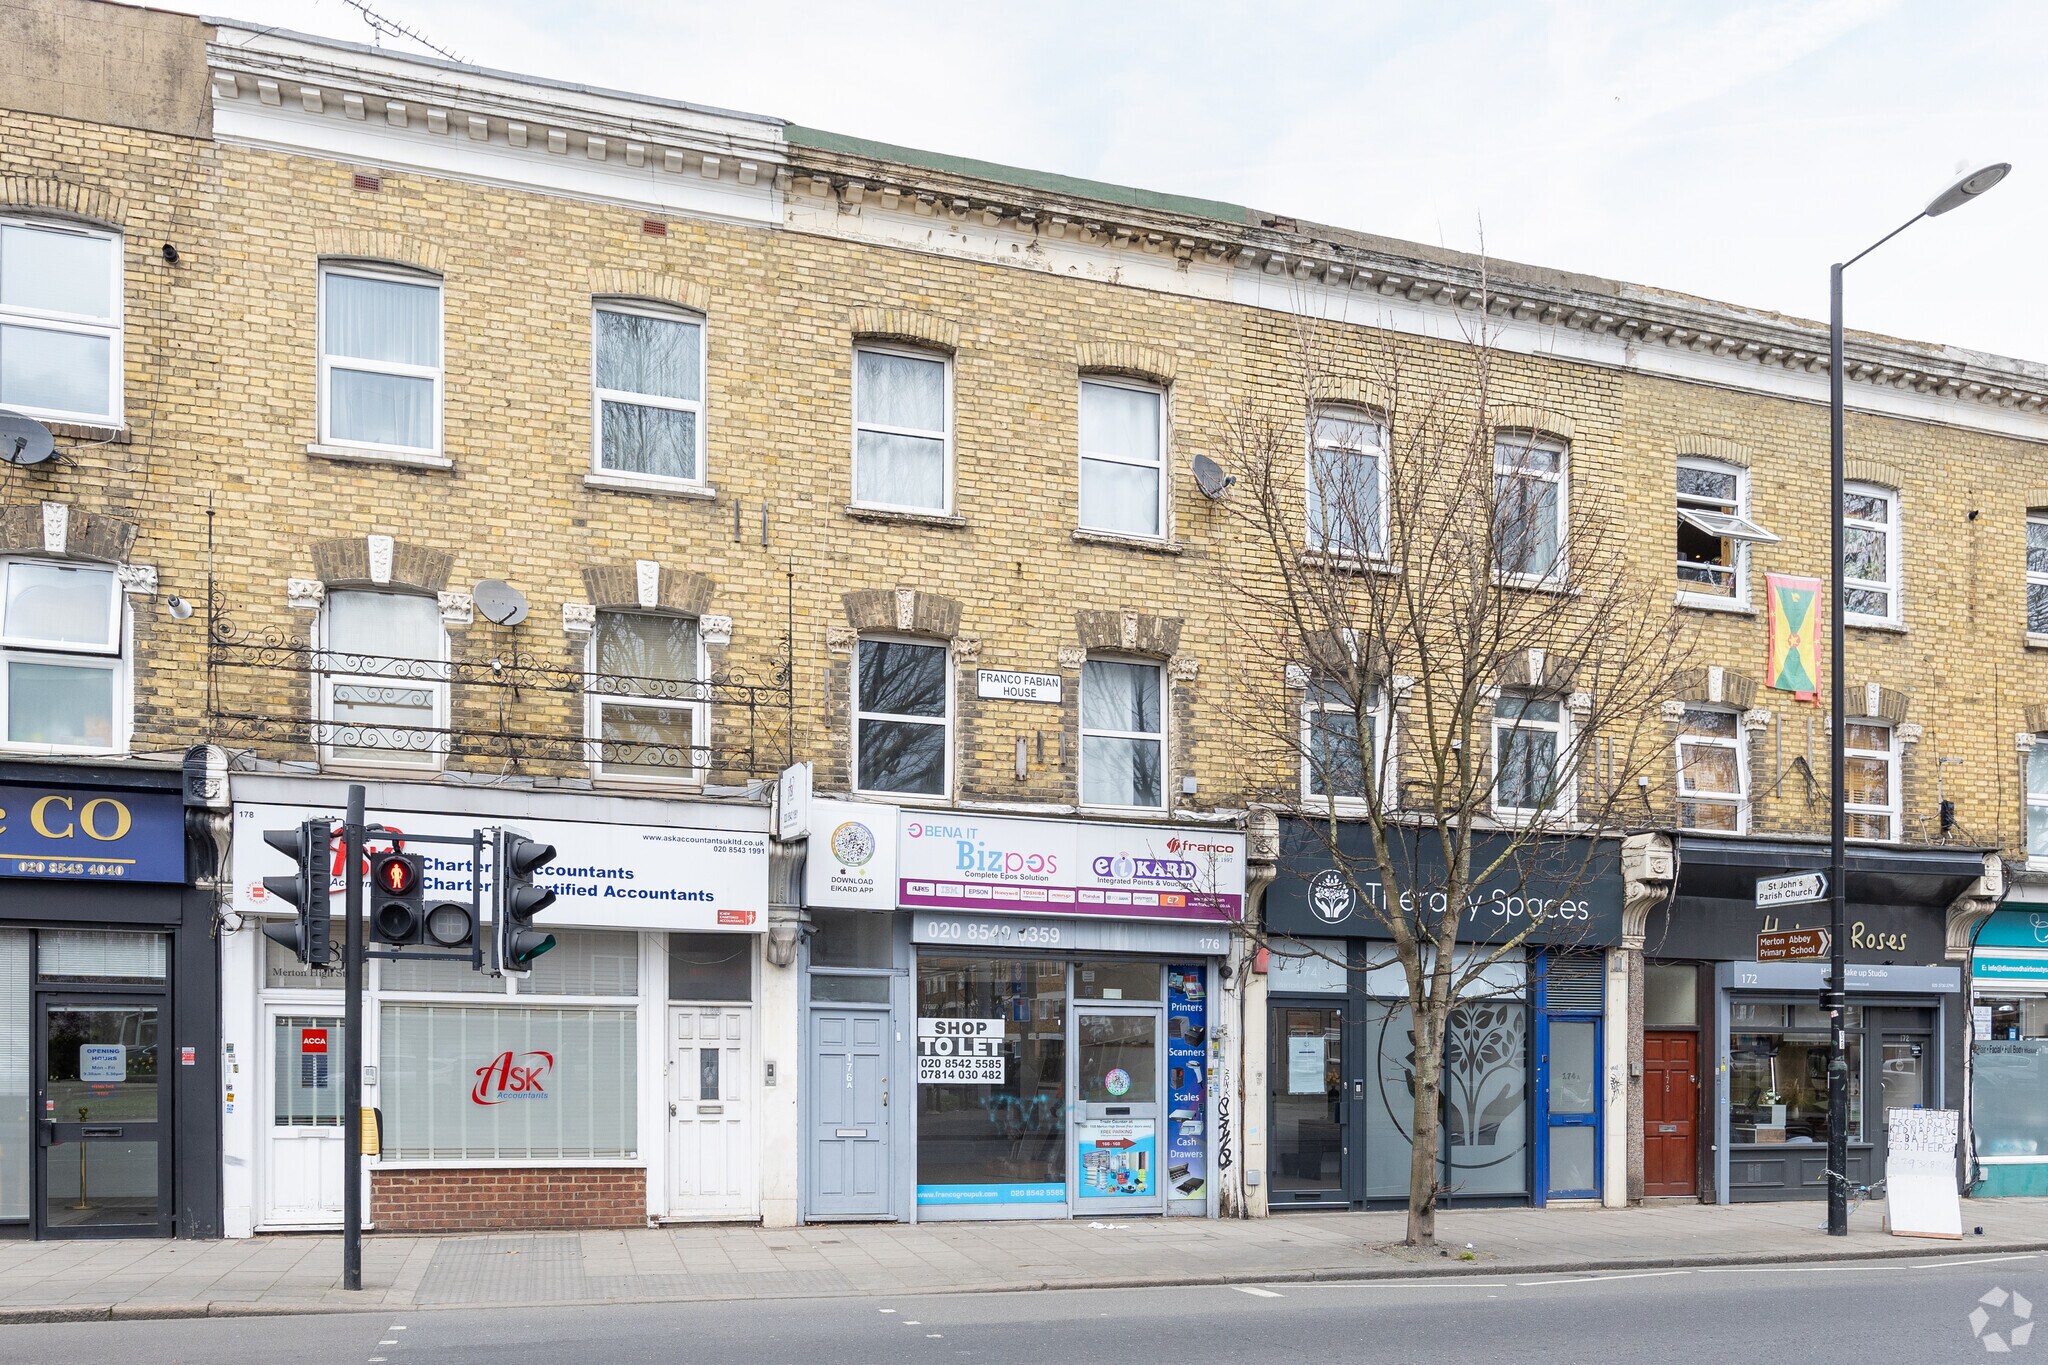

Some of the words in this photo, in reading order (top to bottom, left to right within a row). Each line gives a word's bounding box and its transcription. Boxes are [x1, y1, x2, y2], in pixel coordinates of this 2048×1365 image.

[980, 673, 1021, 685] FRANCO
[1024, 676, 1058, 687] FABIAN
[1003, 687, 1037, 698] HOUSE
[30, 795, 132, 841] CO
[239, 810, 254, 819] 178
[925, 825, 963, 839] BENA
[966, 828, 978, 839] IT
[642, 834, 765, 847] www.askaccountantsukltd.co.uk
[728, 846, 746, 854] 8543
[749, 847, 765, 855] 1991
[1182, 840, 1234, 853] franco
[18, 861, 45, 873] 020
[48, 862, 84, 875] 8543
[87, 864, 125, 876] 4040
[533, 864, 635, 880] ccountants
[831, 876, 874, 885] DOWNLOAD
[964, 870, 998, 880] Complete
[1000, 873, 1018, 881] Epos
[1020, 873, 1049, 882] Solution
[1097, 876, 1132, 885] Integrated
[1133, 878, 1154, 886] Points
[1162, 879, 1193, 888] Vouchers
[1768, 882, 1777, 890] St
[1780, 880, 1803, 889] John's
[604, 885, 715, 902] Accountants
[941, 886, 959, 894] IBM
[1759, 892, 1783, 900] Parish
[1785, 888, 1813, 898] Church
[1366, 882, 1483, 922] Teray
[1491, 889, 1589, 923] Spaces
[927, 921, 961, 938] 020
[1760, 937, 1785, 946] Merton
[1789, 935, 1811, 944] Abbey
[1851, 921, 1907, 951] Roses
[1199, 938, 1220, 950] 176
[1760, 948, 1787, 957] Primary
[1790, 945, 1816, 955] School
[272, 968, 306, 977] Merton
[1844, 968, 1857, 976] ake
[1868, 969, 1888, 977] Studio
[1741, 974, 1758, 984] 172
[1171, 1002, 1203, 1012] Printers
[934, 1021, 988, 1035] SHOP
[303, 1037, 326, 1045] ACCA
[920, 1037, 953, 1056] TO
[958, 1037, 1003, 1056] LET
[1168, 1047, 1206, 1057] Scanners
[921, 1058, 941, 1068] 020
[944, 1058, 972, 1068] 8542
[975, 1059, 1002, 1069] 5585
[921, 1069, 955, 1079] 07814
[958, 1070, 978, 1080] 030
[981, 1070, 1002, 1080] 482
[496, 1091, 549, 1099] Accountants
[1174, 1092, 1200, 1102] Scales
[1889, 1124, 1957, 1136] KIDNAPPING
[1176, 1137, 1197, 1146] Cash
[1170, 1150, 1203, 1158] Drawers
[917, 1190, 998, 1199] www.francogroupuk.com
[1010, 1189, 1024, 1197] 020
